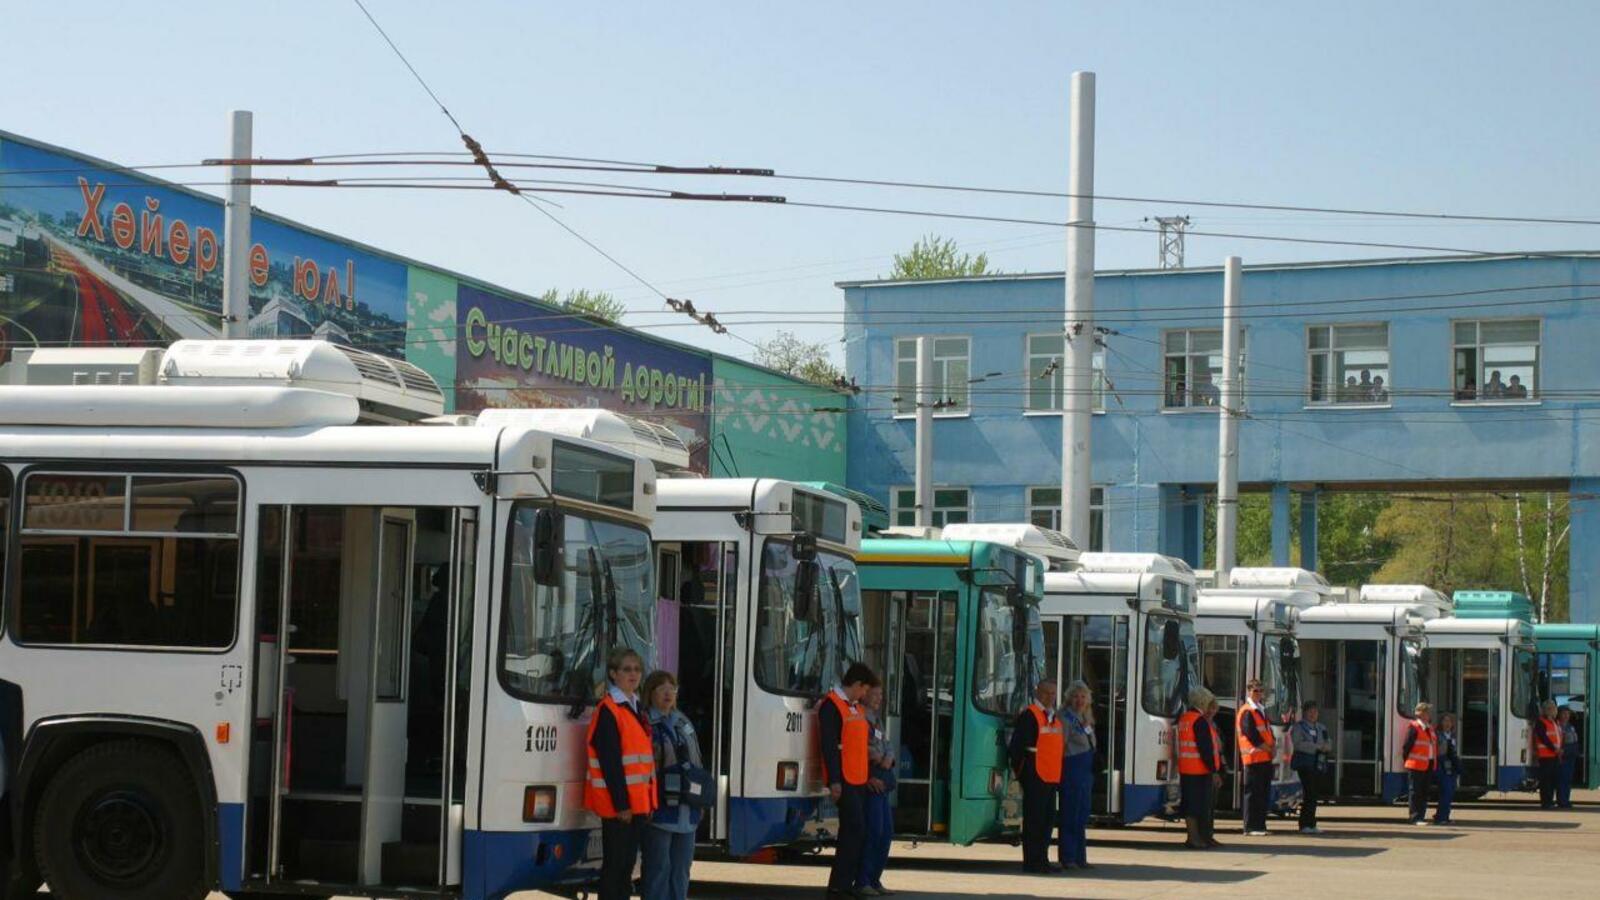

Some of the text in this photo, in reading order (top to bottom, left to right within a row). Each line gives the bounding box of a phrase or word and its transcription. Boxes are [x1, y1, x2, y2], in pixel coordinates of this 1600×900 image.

[76, 175, 354, 310] Хәйере юл!
[466, 307, 705, 413] Счастливой дороги!
[524, 725, 558, 753] 1010
